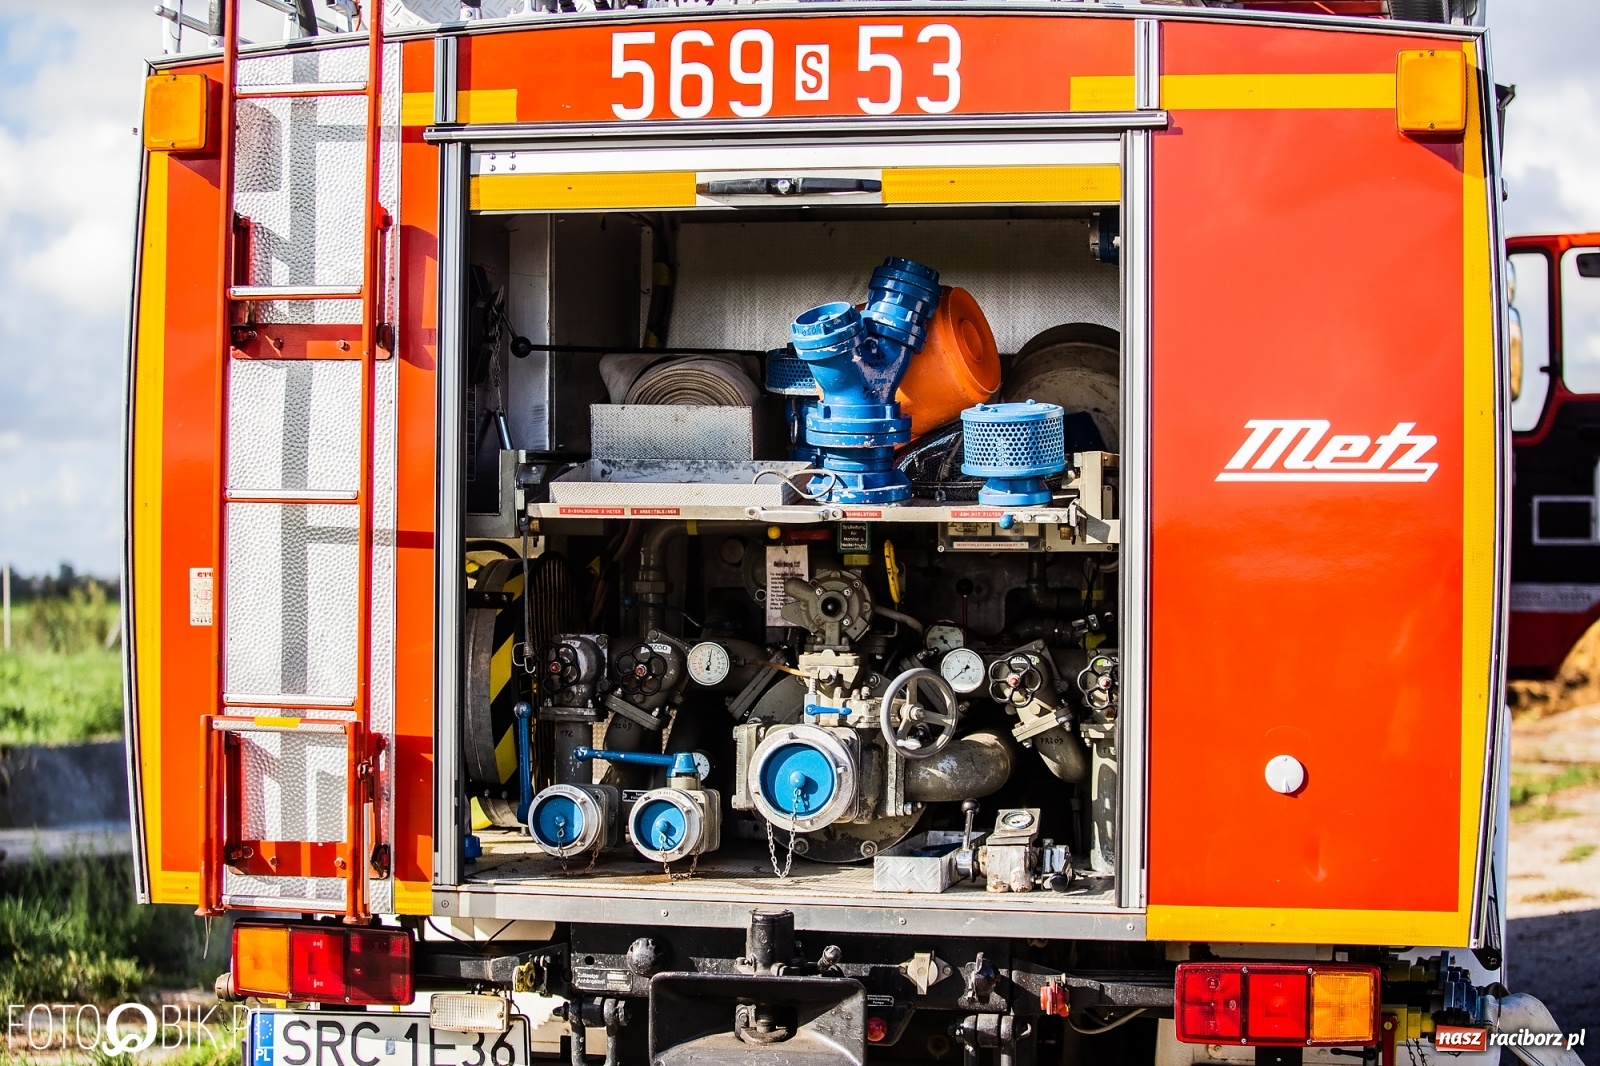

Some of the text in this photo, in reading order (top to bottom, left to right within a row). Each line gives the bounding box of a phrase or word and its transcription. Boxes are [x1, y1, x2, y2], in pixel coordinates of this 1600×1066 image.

[611, 23, 962, 121] 569 S 53
[1214, 419, 1439, 482] Metz
[255, 1049, 271, 1062] PL
[282, 1020, 516, 1066] SRC 1E36
